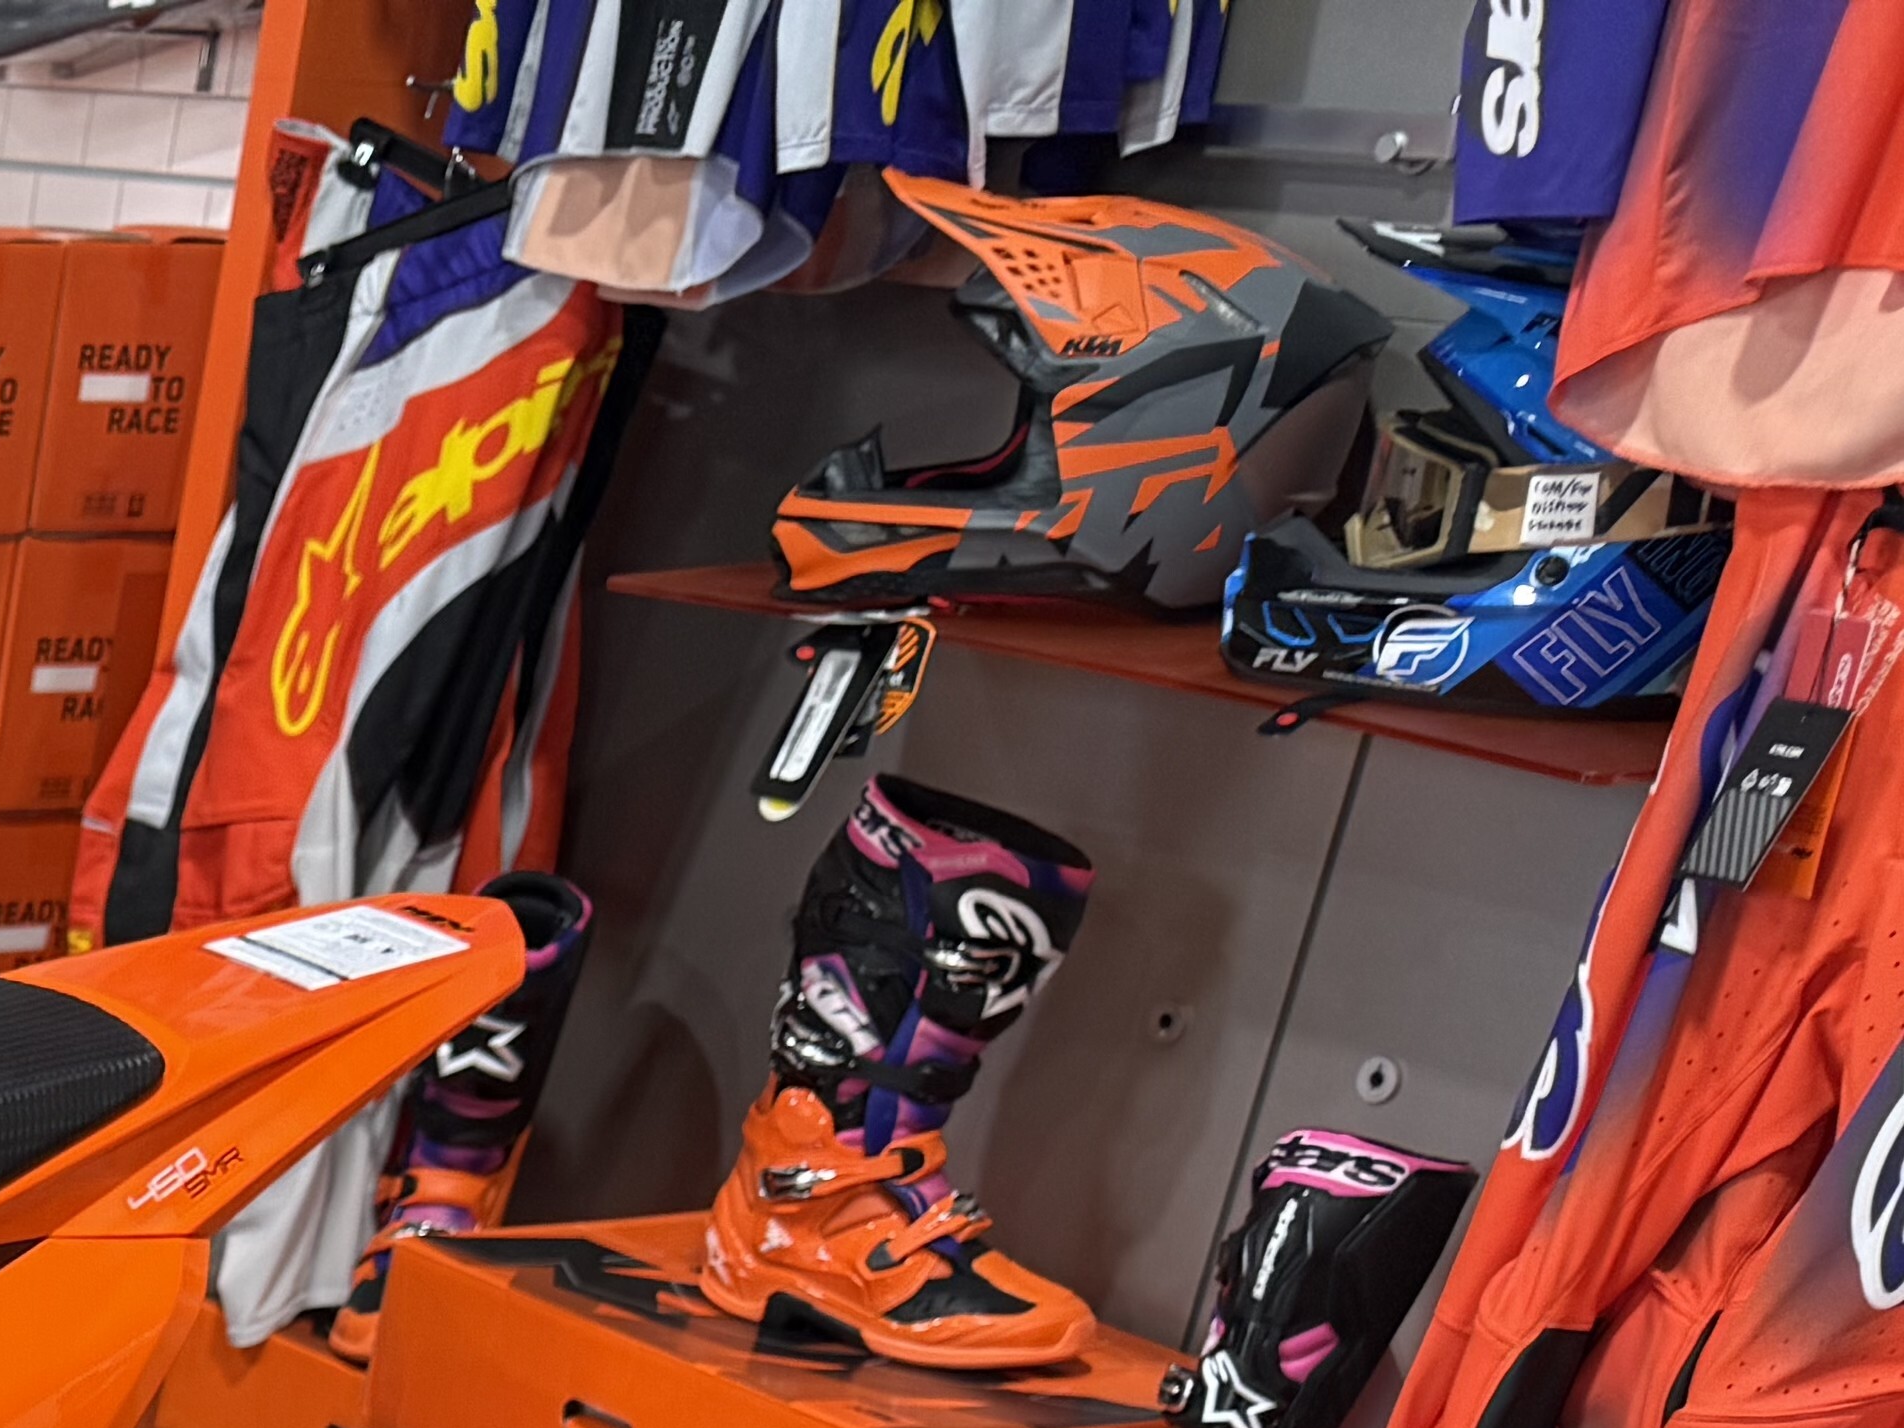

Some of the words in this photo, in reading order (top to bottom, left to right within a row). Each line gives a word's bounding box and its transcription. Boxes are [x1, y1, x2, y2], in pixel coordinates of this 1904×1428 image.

[78, 343, 172, 371] READY
[150, 375, 185, 402] TO
[107, 407, 180, 435] RACE
[1512, 565, 1662, 706] FLY
[1252, 647, 1319, 672] FLY
[127, 1146, 209, 1210] 450
[183, 1146, 245, 1199] SMR
